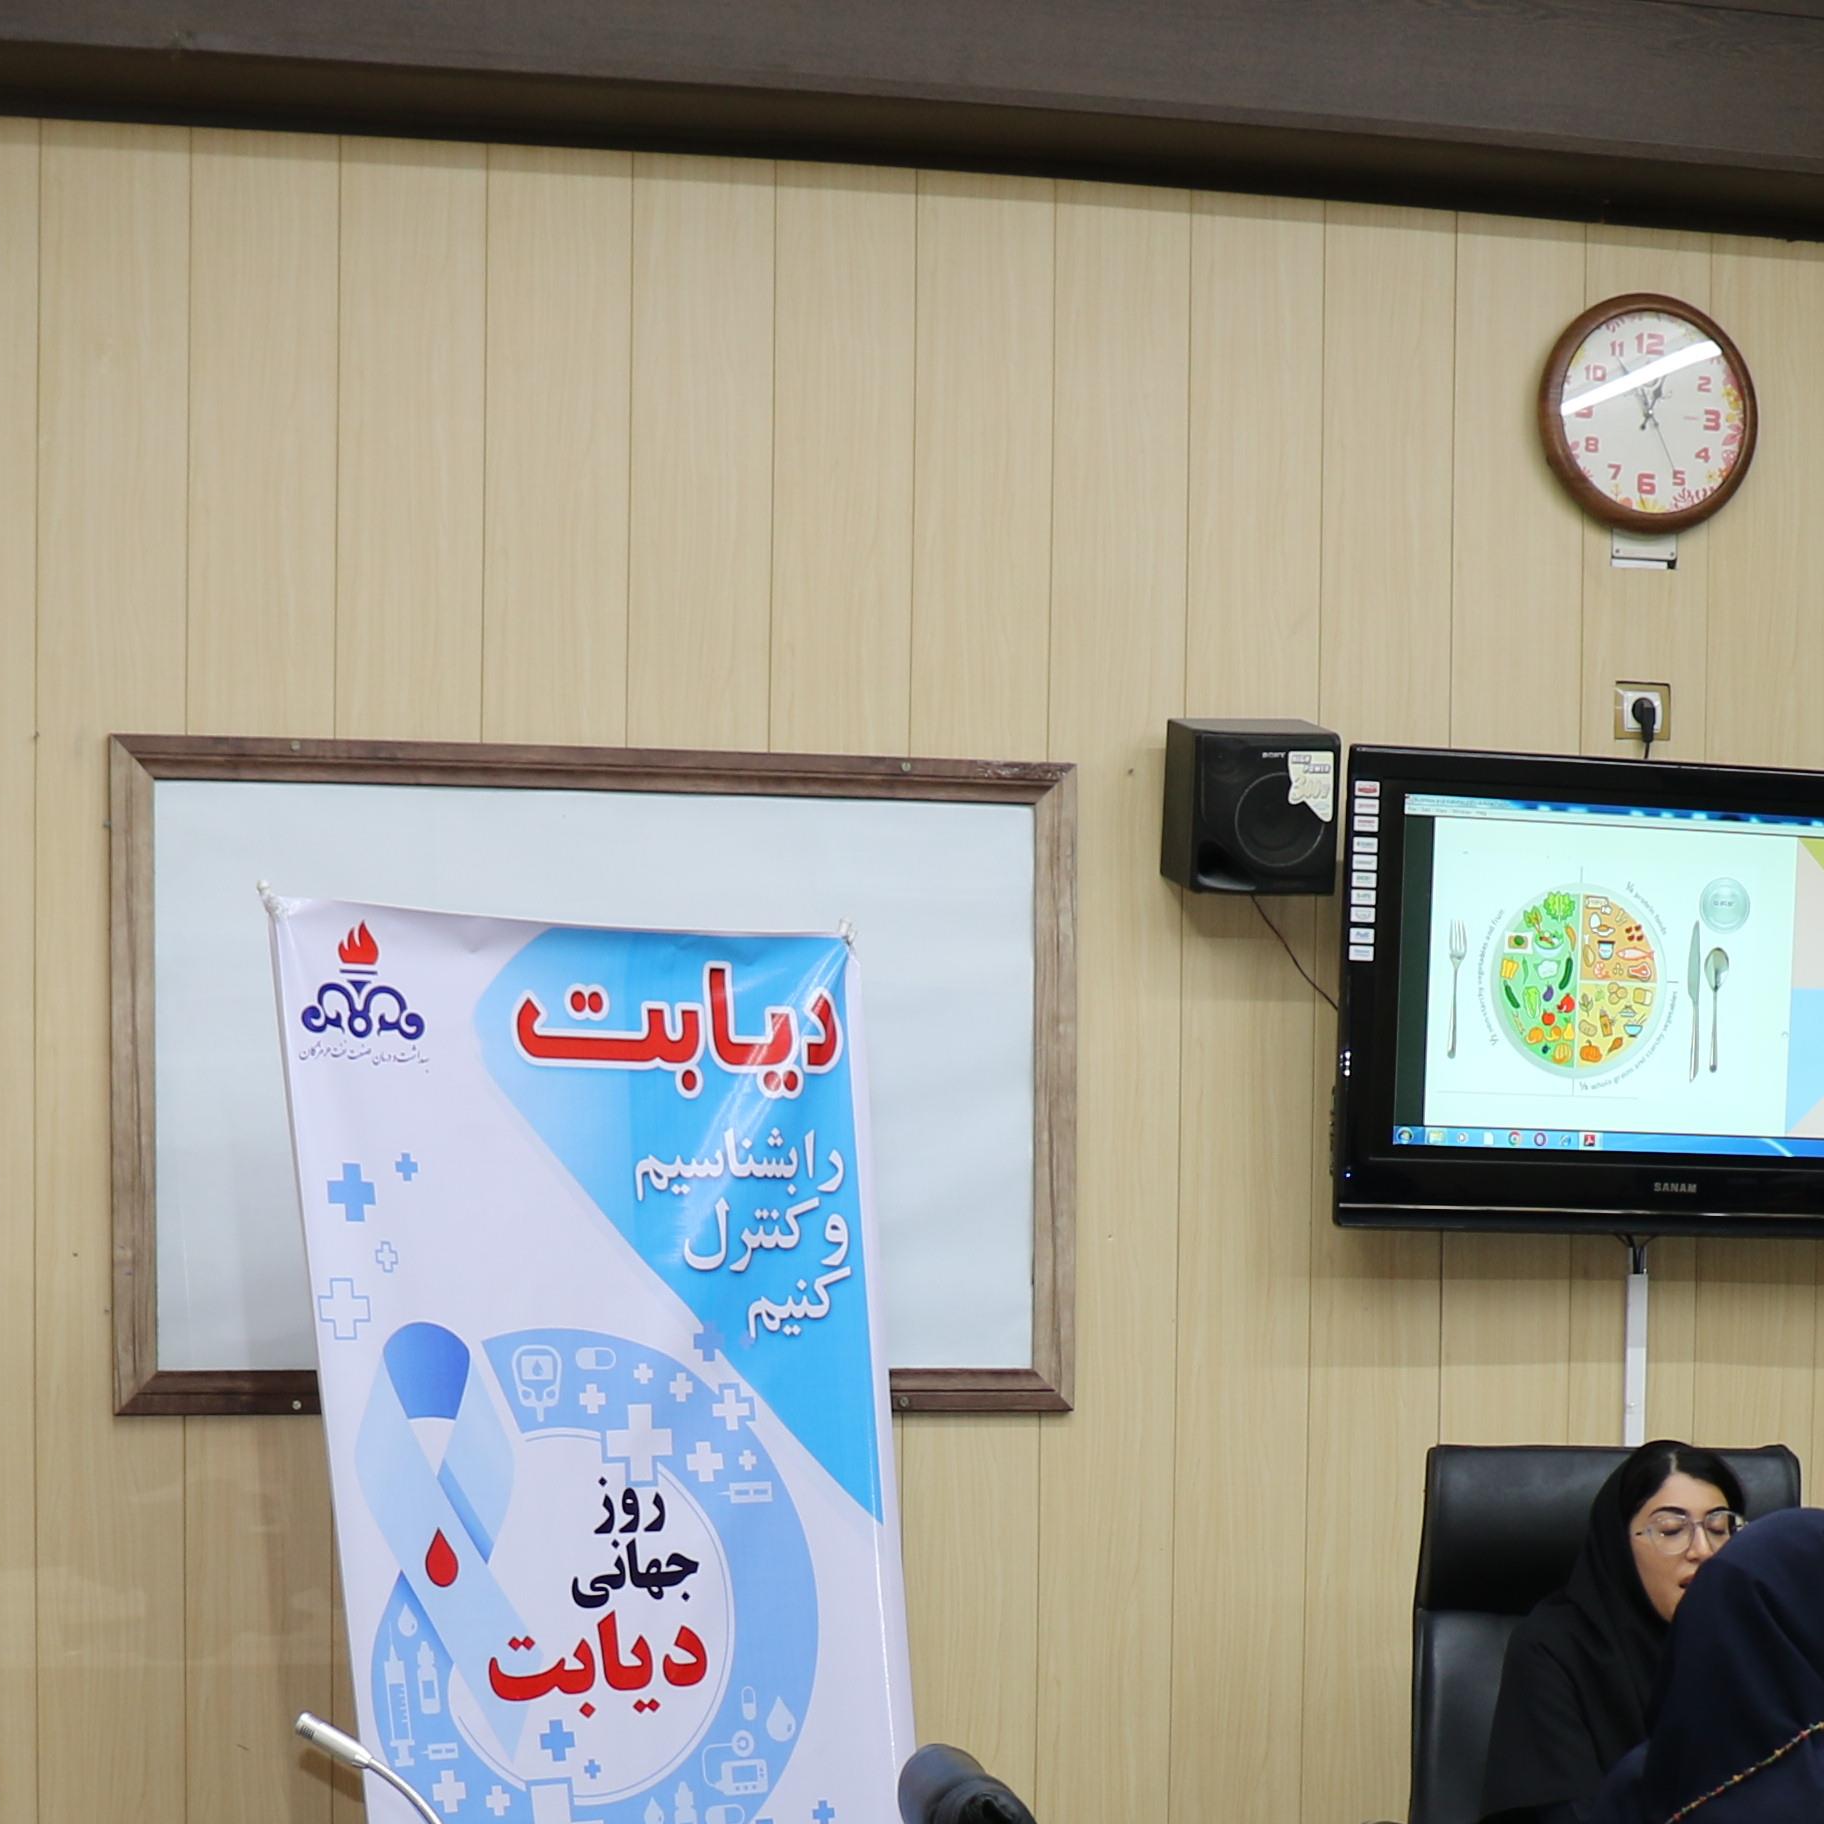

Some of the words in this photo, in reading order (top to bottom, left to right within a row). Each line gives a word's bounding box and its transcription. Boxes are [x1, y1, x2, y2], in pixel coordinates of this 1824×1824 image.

[1610, 341, 1624, 356] 11
[1635, 333, 1664, 355] 12
[1585, 365, 1607, 381] 10
[1697, 376, 1712, 392] 2
[1703, 410, 1721, 431] 3
[1585, 437, 1599, 452] 8
[1695, 448, 1710, 463] 4
[1608, 464, 1622, 480] 7
[1673, 470, 1686, 486] 5
[1637, 473, 1656, 495] 6
[514, 963, 843, 1099] دیابت
[635, 1127, 799, 1202] بشناسیم
[806, 1130, 845, 1193] را
[1654, 1182, 1697, 1193] SANAM
[684, 1197, 821, 1273] کنترل
[820, 1209, 851, 1267] و
[747, 1267, 851, 1339] کنیم
[594, 1476, 666, 1534] روز
[572, 1537, 700, 1609] جهانی
[488, 1610, 709, 1718] دیابت
